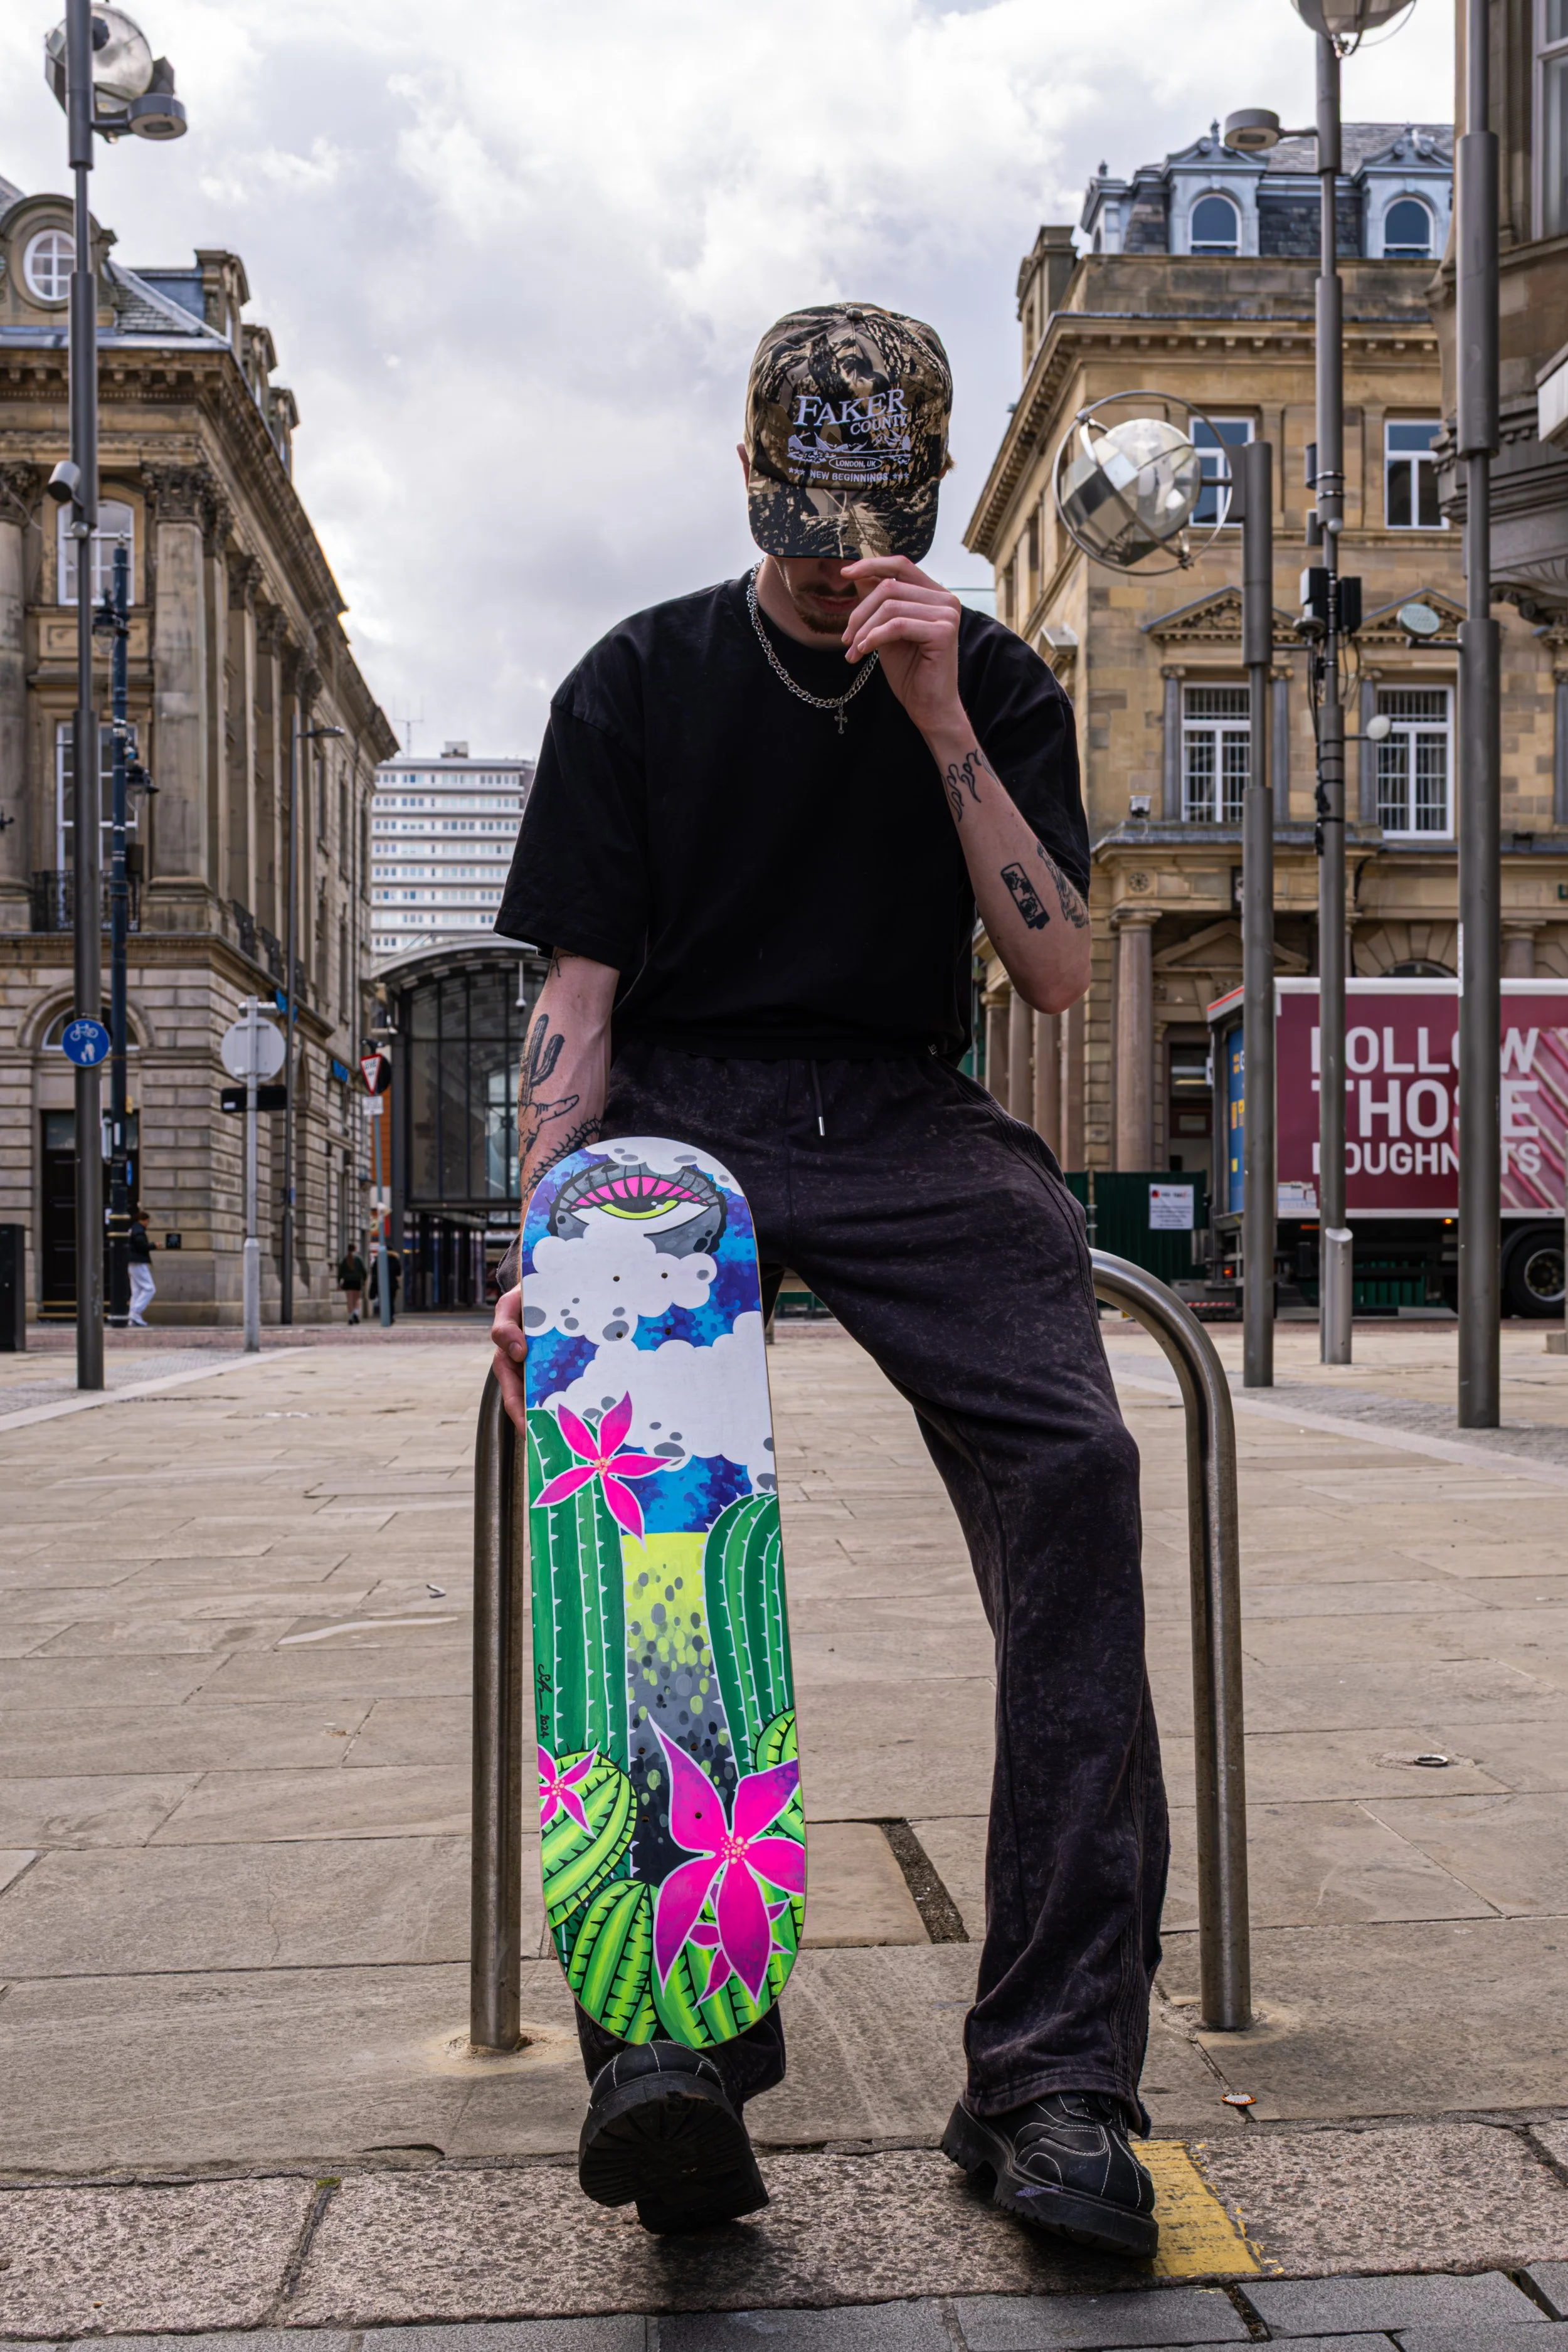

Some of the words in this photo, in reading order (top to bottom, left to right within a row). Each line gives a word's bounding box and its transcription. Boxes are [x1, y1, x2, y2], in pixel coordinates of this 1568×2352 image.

[793, 388, 908, 426] FAKER
[850, 414, 908, 435] COUNTY
[810, 470, 830, 480] NEW
[832, 472, 888, 483] BEGINNINGS
[835, 459, 866, 469] LONDON,
[867, 459, 876, 468] UK
[1311, 1026, 1539, 1074] OLLW
[1311, 1079, 1539, 1138] HOE
[1313, 1142, 1541, 1175] OUGHNTS
[540, 1714, 550, 1739] 2024
